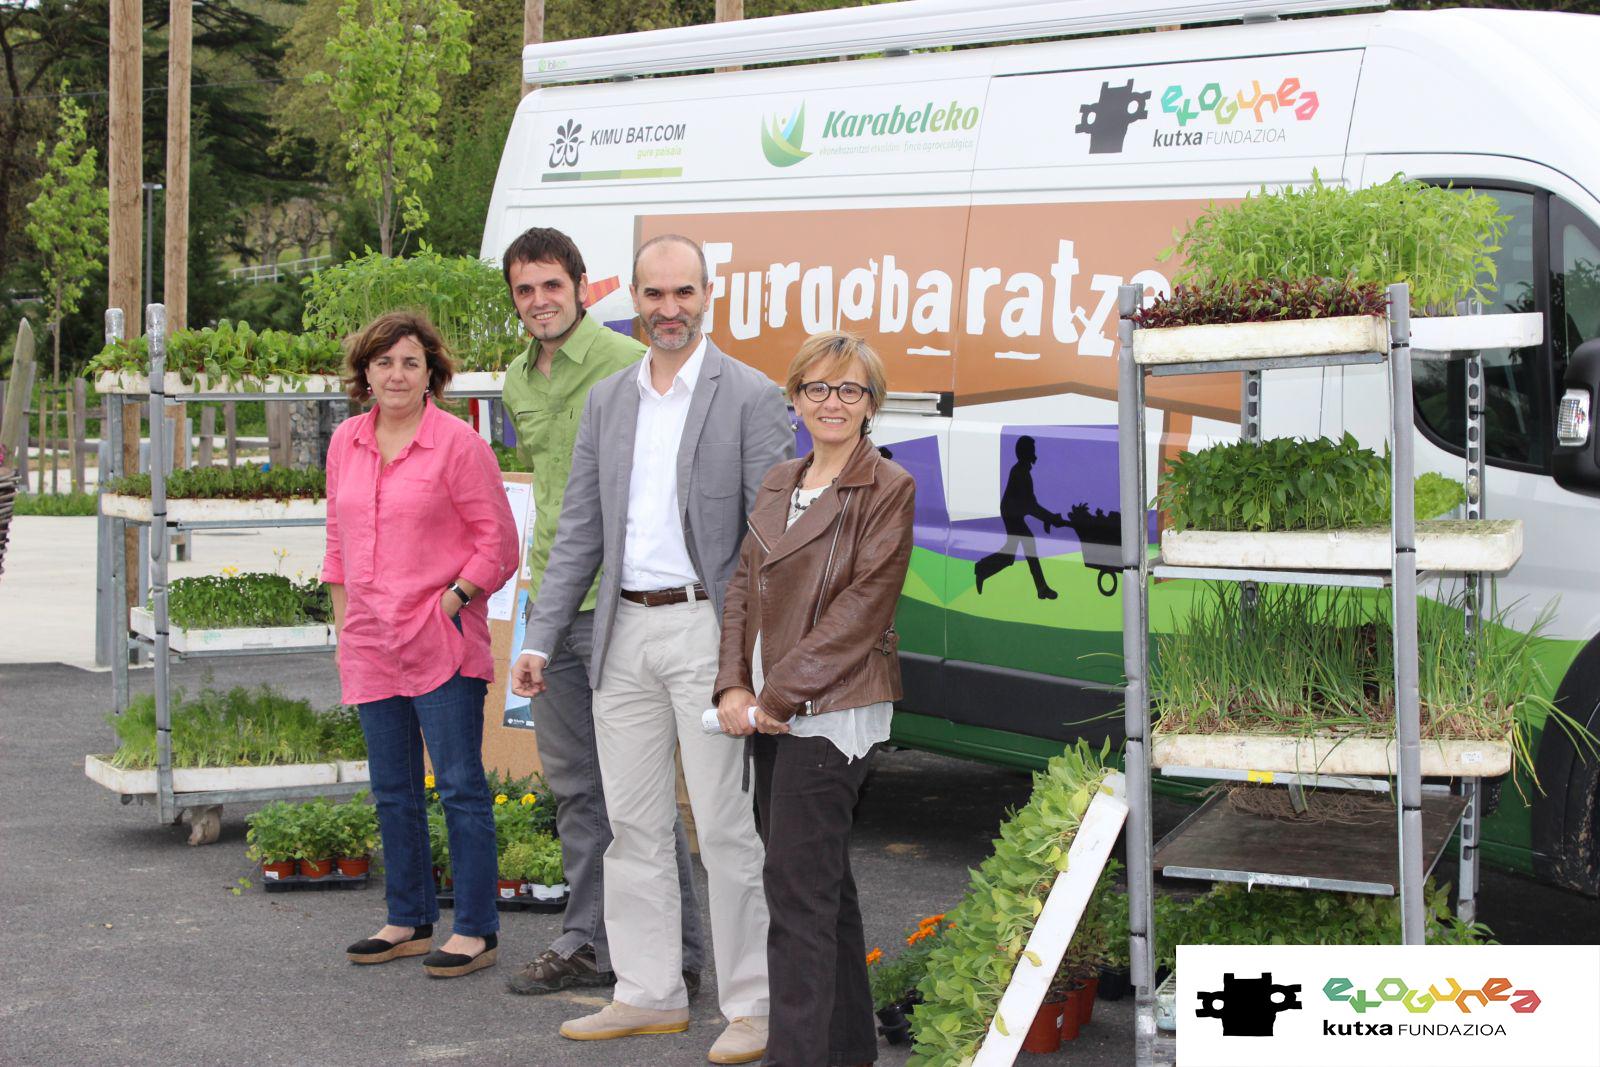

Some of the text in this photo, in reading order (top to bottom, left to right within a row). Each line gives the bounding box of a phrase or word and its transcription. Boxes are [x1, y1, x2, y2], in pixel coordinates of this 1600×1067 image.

[821, 100, 980, 139] Karabeleko
[590, 123, 687, 146] KIMU BAT.COM
[1152, 128, 1287, 148] kutxa FUNDAZIOA
